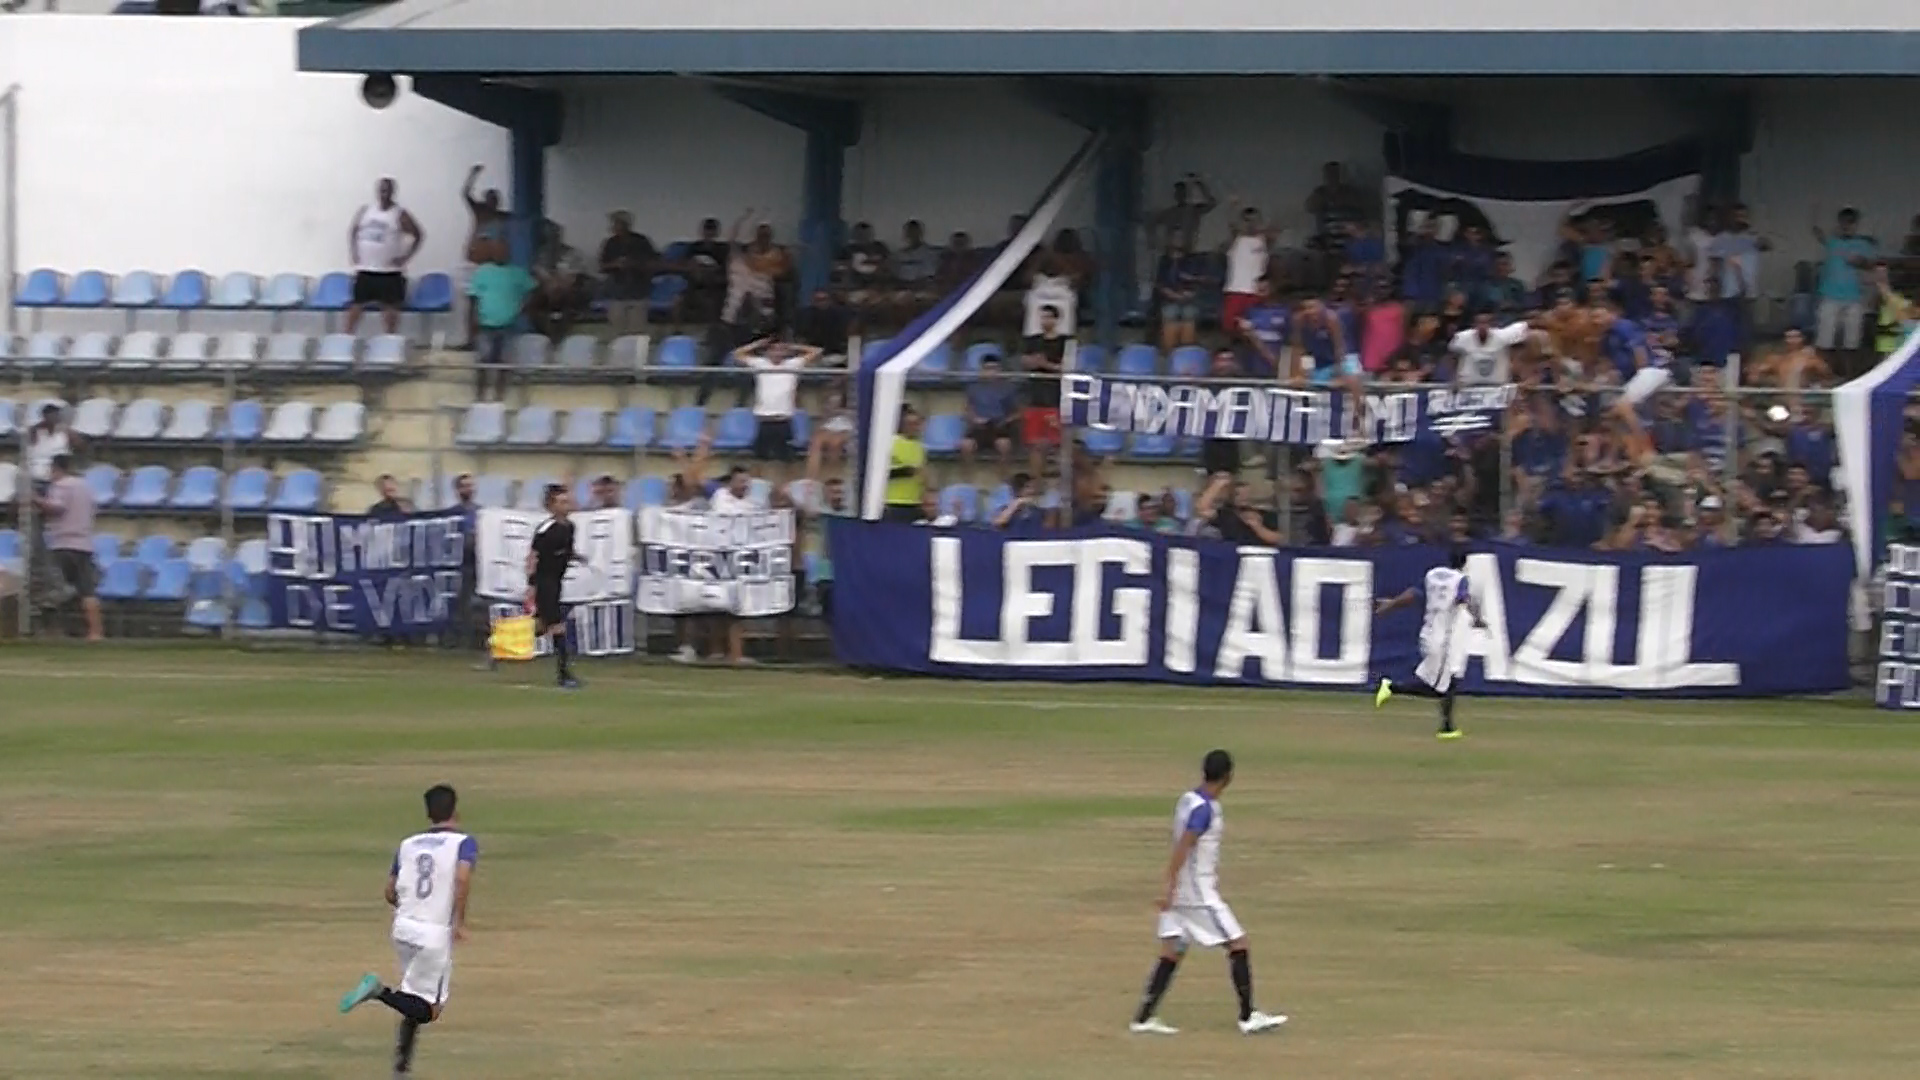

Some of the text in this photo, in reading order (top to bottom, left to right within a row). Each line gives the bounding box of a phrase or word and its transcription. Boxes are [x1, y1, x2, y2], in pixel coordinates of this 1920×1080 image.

[267, 514, 337, 580] 90
[286, 584, 356, 629] DE
[929, 536, 1374, 684] LEGIÃO
[1445, 553, 1741, 689] AZUL
[416, 853, 435, 899] 8
